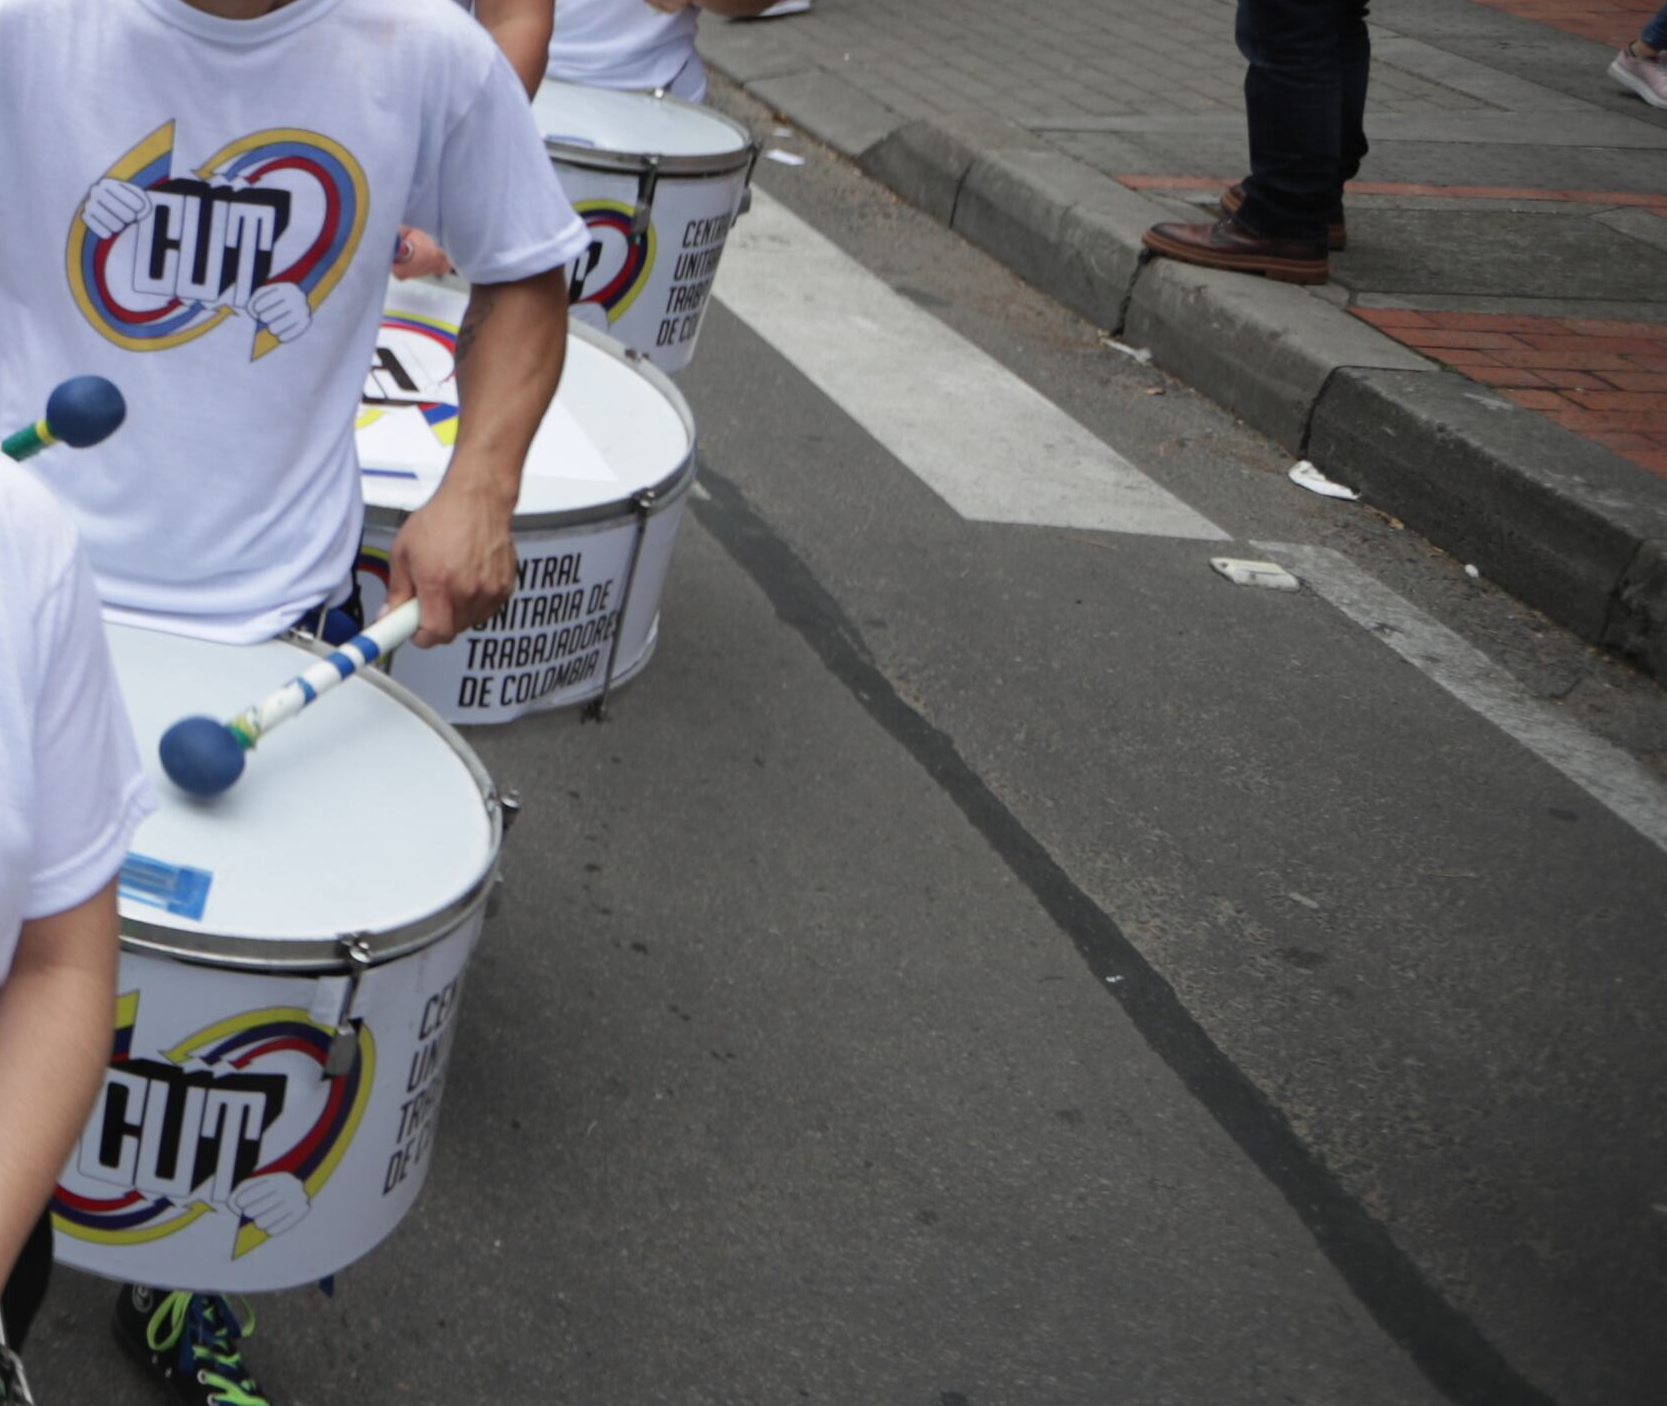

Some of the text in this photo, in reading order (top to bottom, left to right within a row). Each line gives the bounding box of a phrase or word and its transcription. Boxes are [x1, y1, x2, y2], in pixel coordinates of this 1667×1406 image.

[133, 177, 292, 309] CUT
[515, 552, 582, 591] NTRAL
[586, 579, 614, 616] DE
[457, 649, 601, 709] DE COLOMBIA
[77, 1059, 288, 1203] CUT
